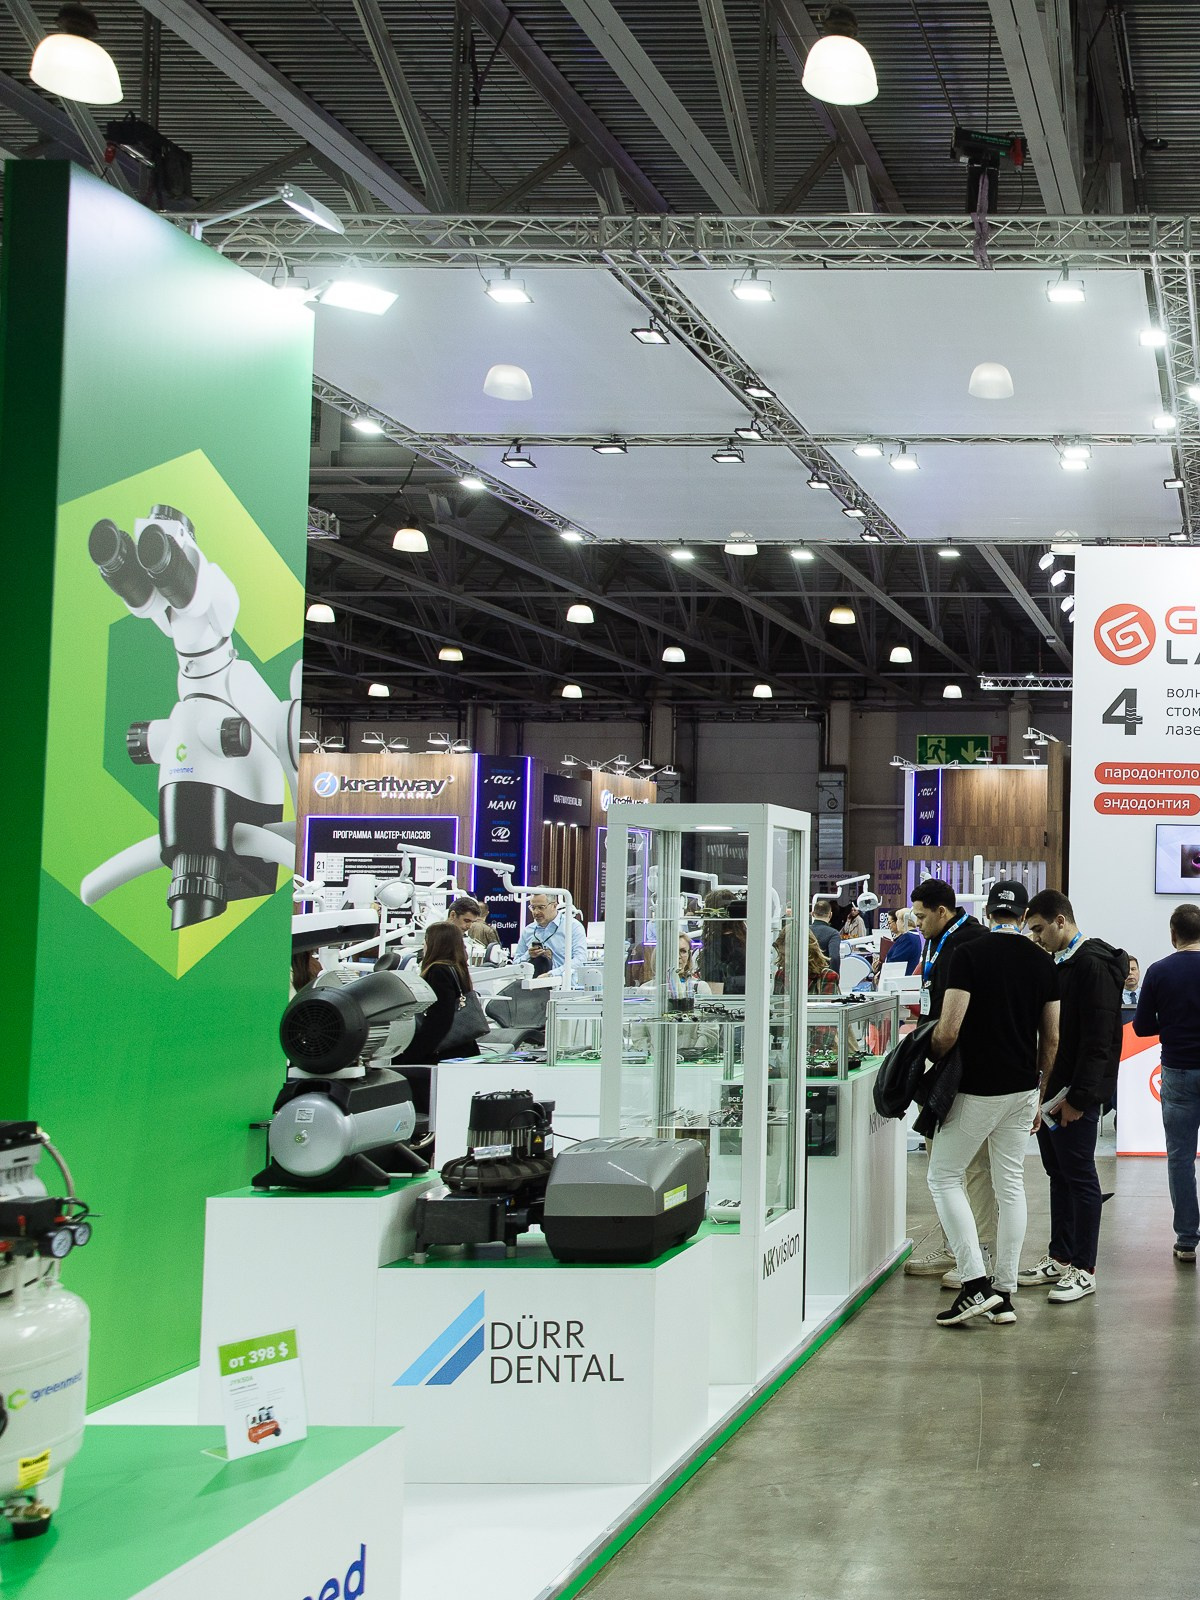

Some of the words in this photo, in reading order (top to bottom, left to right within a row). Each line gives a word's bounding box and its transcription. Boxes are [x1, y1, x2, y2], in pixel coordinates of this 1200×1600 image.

[1102, 688, 1143, 736] 4
[340, 776, 446, 796] kraftway
[487, 800, 517, 810] MANI
[1103, 797, 1190, 810] эндодонтия
[333, 830, 372, 840] ПРОГРАММА
[374, 830, 431, 840] МАСТЕР-КЛАССОВ
[316, 861, 326, 870] 21
[484, 894, 514, 903] parkell
[490, 1314, 585, 1350] DÜRR
[248, 1346, 276, 1363] 398
[278, 1341, 289, 1358] $
[490, 1353, 625, 1385] DENTAL
